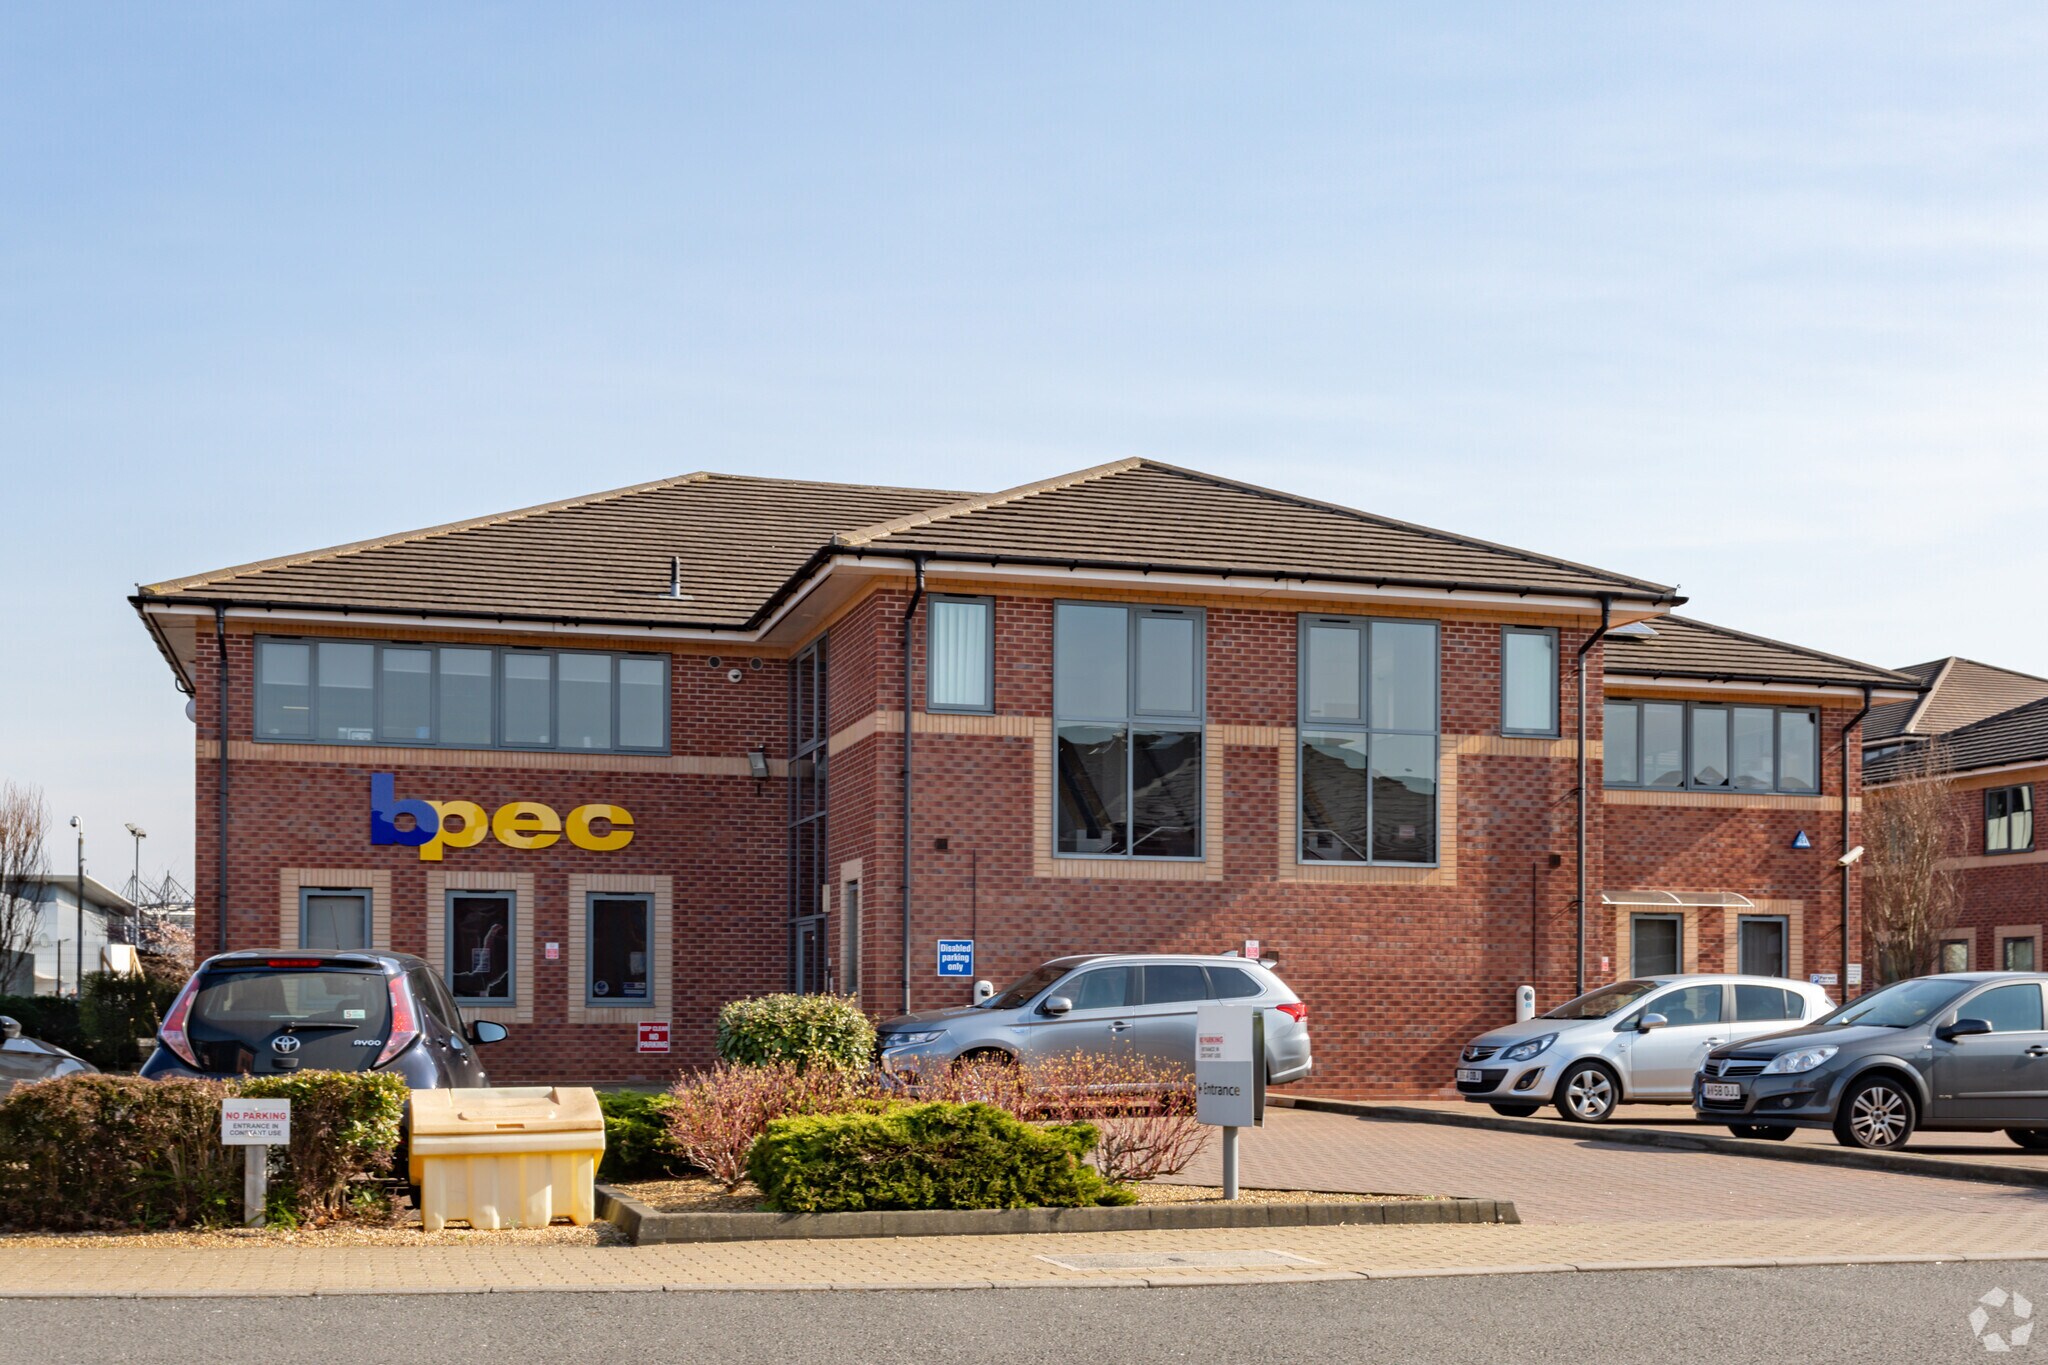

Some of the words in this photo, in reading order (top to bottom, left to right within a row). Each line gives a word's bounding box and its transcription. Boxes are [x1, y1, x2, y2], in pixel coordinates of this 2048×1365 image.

[370, 772, 635, 861] bpec
[940, 944, 971, 952] Disabled
[942, 953, 970, 963] parking
[947, 963, 963, 972] only
[1203, 1082, 1240, 1096] Entrance
